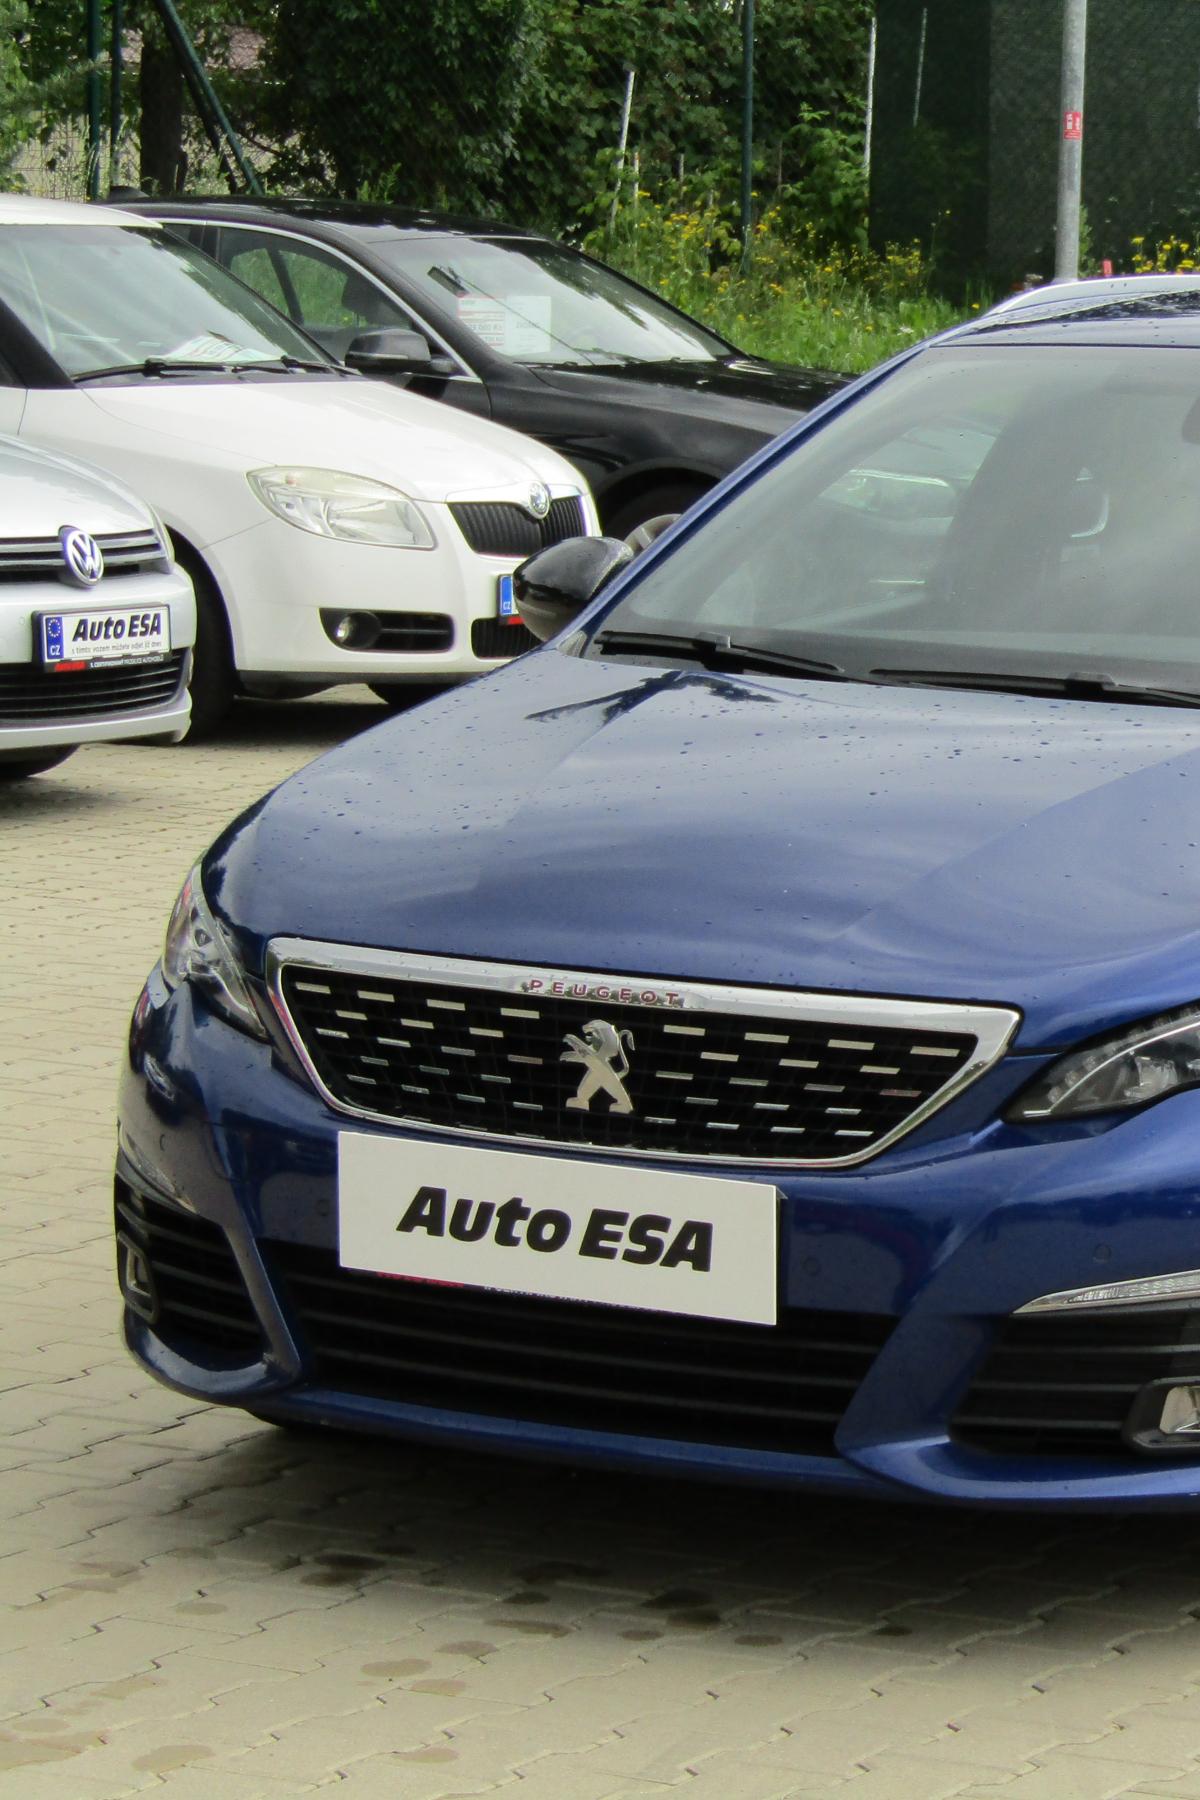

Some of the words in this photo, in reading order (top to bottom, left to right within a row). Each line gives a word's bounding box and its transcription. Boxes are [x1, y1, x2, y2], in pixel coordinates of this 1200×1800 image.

[72, 617, 125, 642] Auto
[128, 613, 161, 638] ESA
[50, 645, 60, 656] CZ
[529, 979, 679, 1005] PEUGEOT
[396, 1186, 572, 1253] Auto
[578, 1208, 713, 1272] ESA
